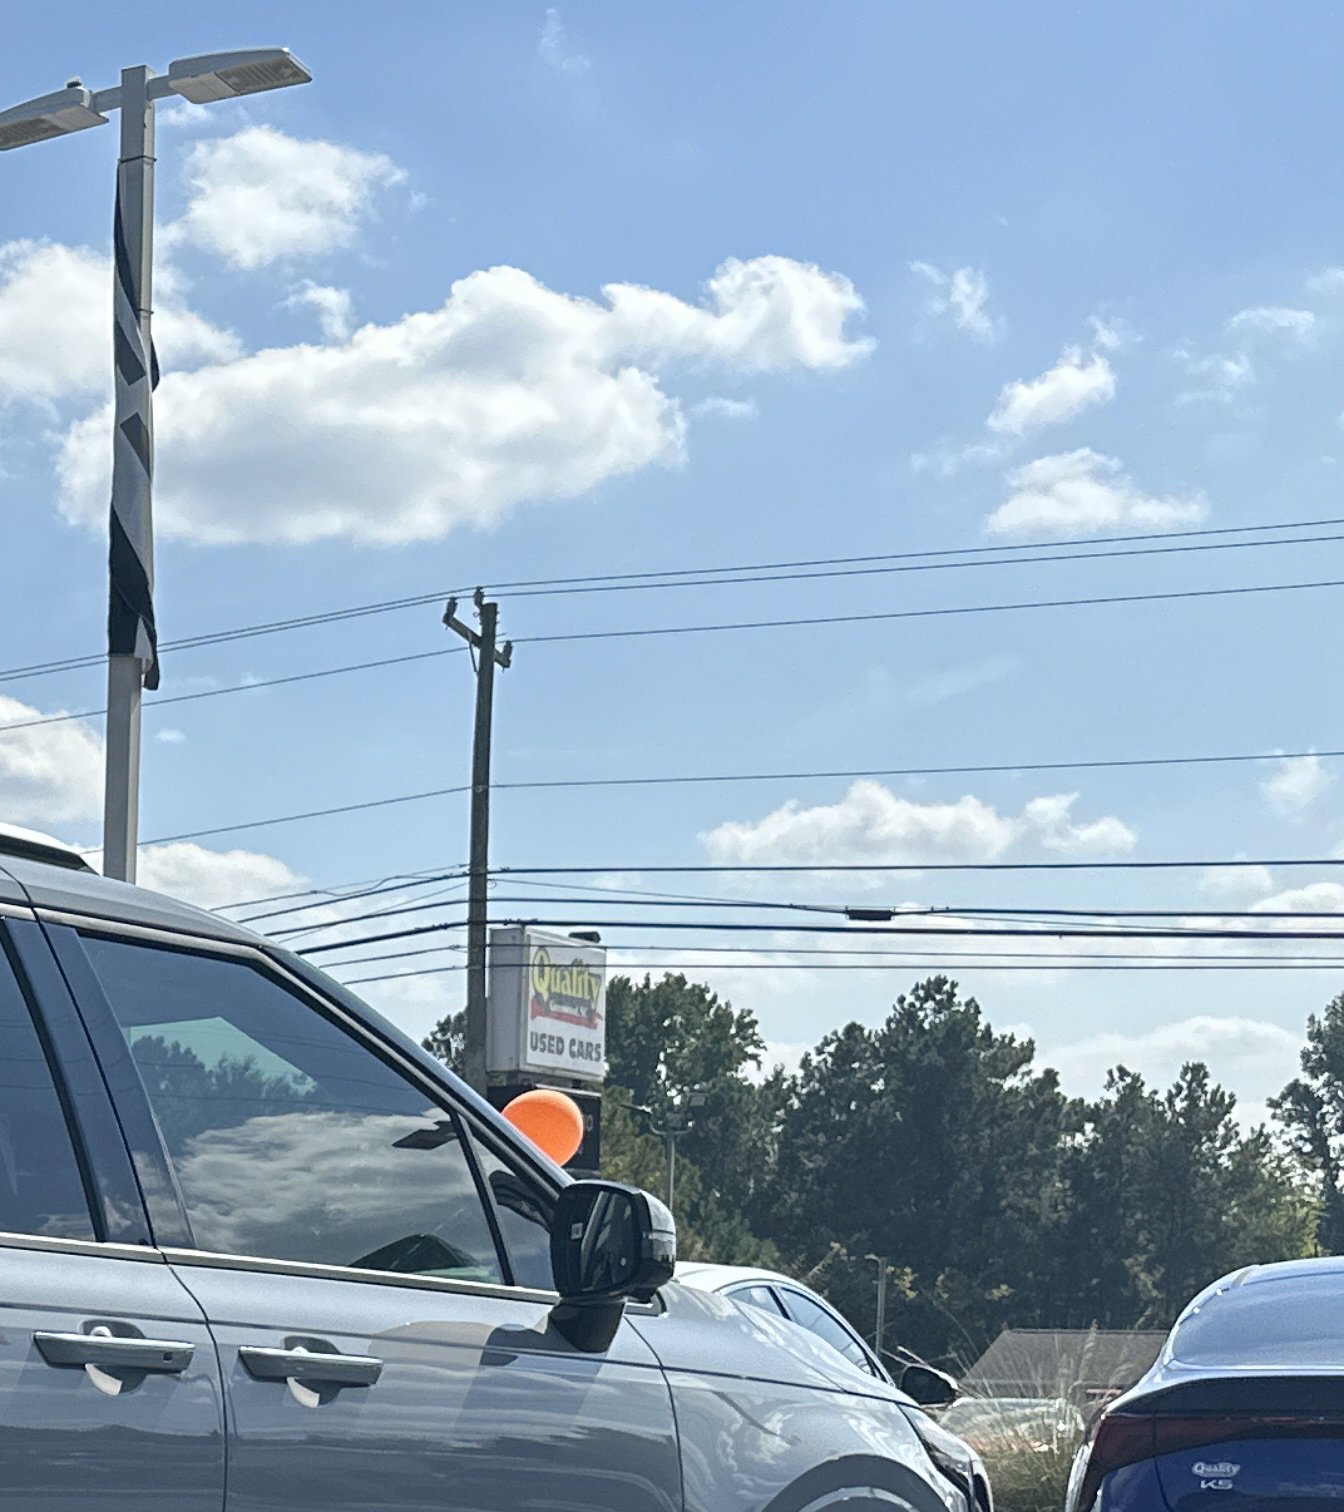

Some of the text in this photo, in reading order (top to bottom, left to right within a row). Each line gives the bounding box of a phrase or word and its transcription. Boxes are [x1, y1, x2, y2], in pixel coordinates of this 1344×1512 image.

[531, 947, 602, 1013] Quality
[529, 1031, 602, 1062] USED CARS
[1200, 1480, 1233, 1490] K5
